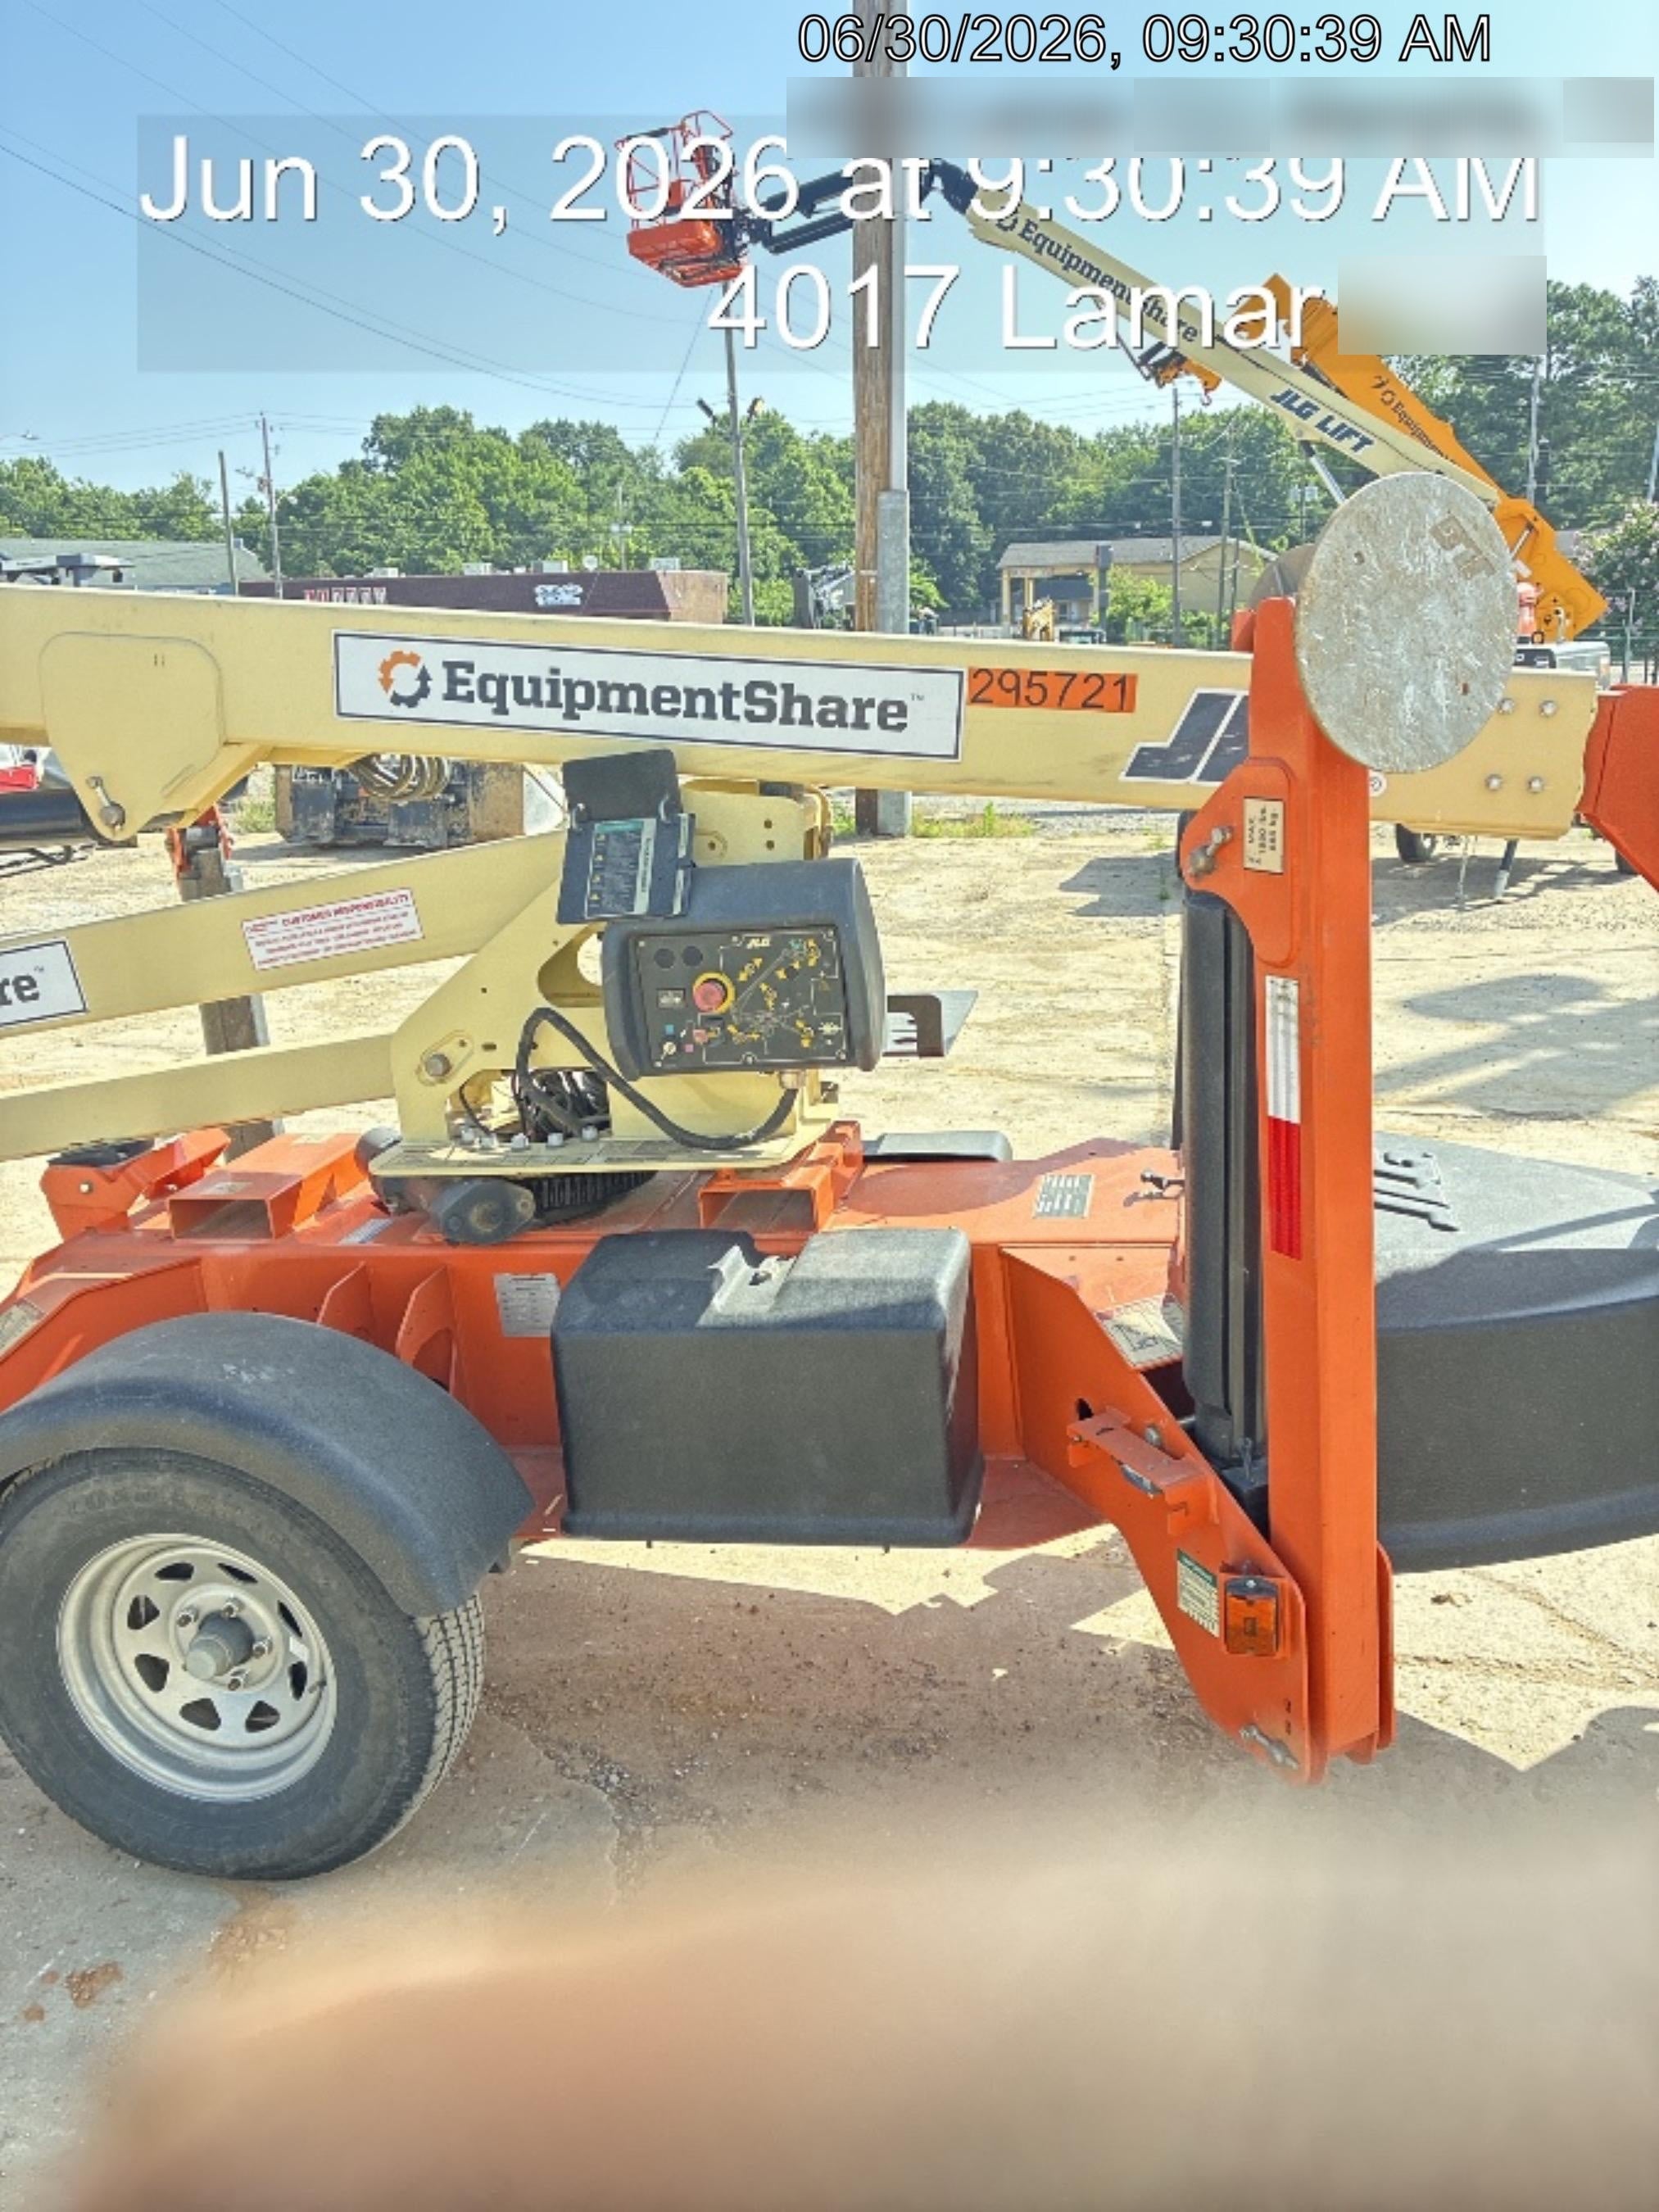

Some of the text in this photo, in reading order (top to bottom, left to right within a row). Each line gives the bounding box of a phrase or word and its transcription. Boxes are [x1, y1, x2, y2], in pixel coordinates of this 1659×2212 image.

[1270, 388, 1375, 452] JLG LIFT
[442, 660, 909, 733] EquipmentShare
[970, 668, 1128, 711] 295721
